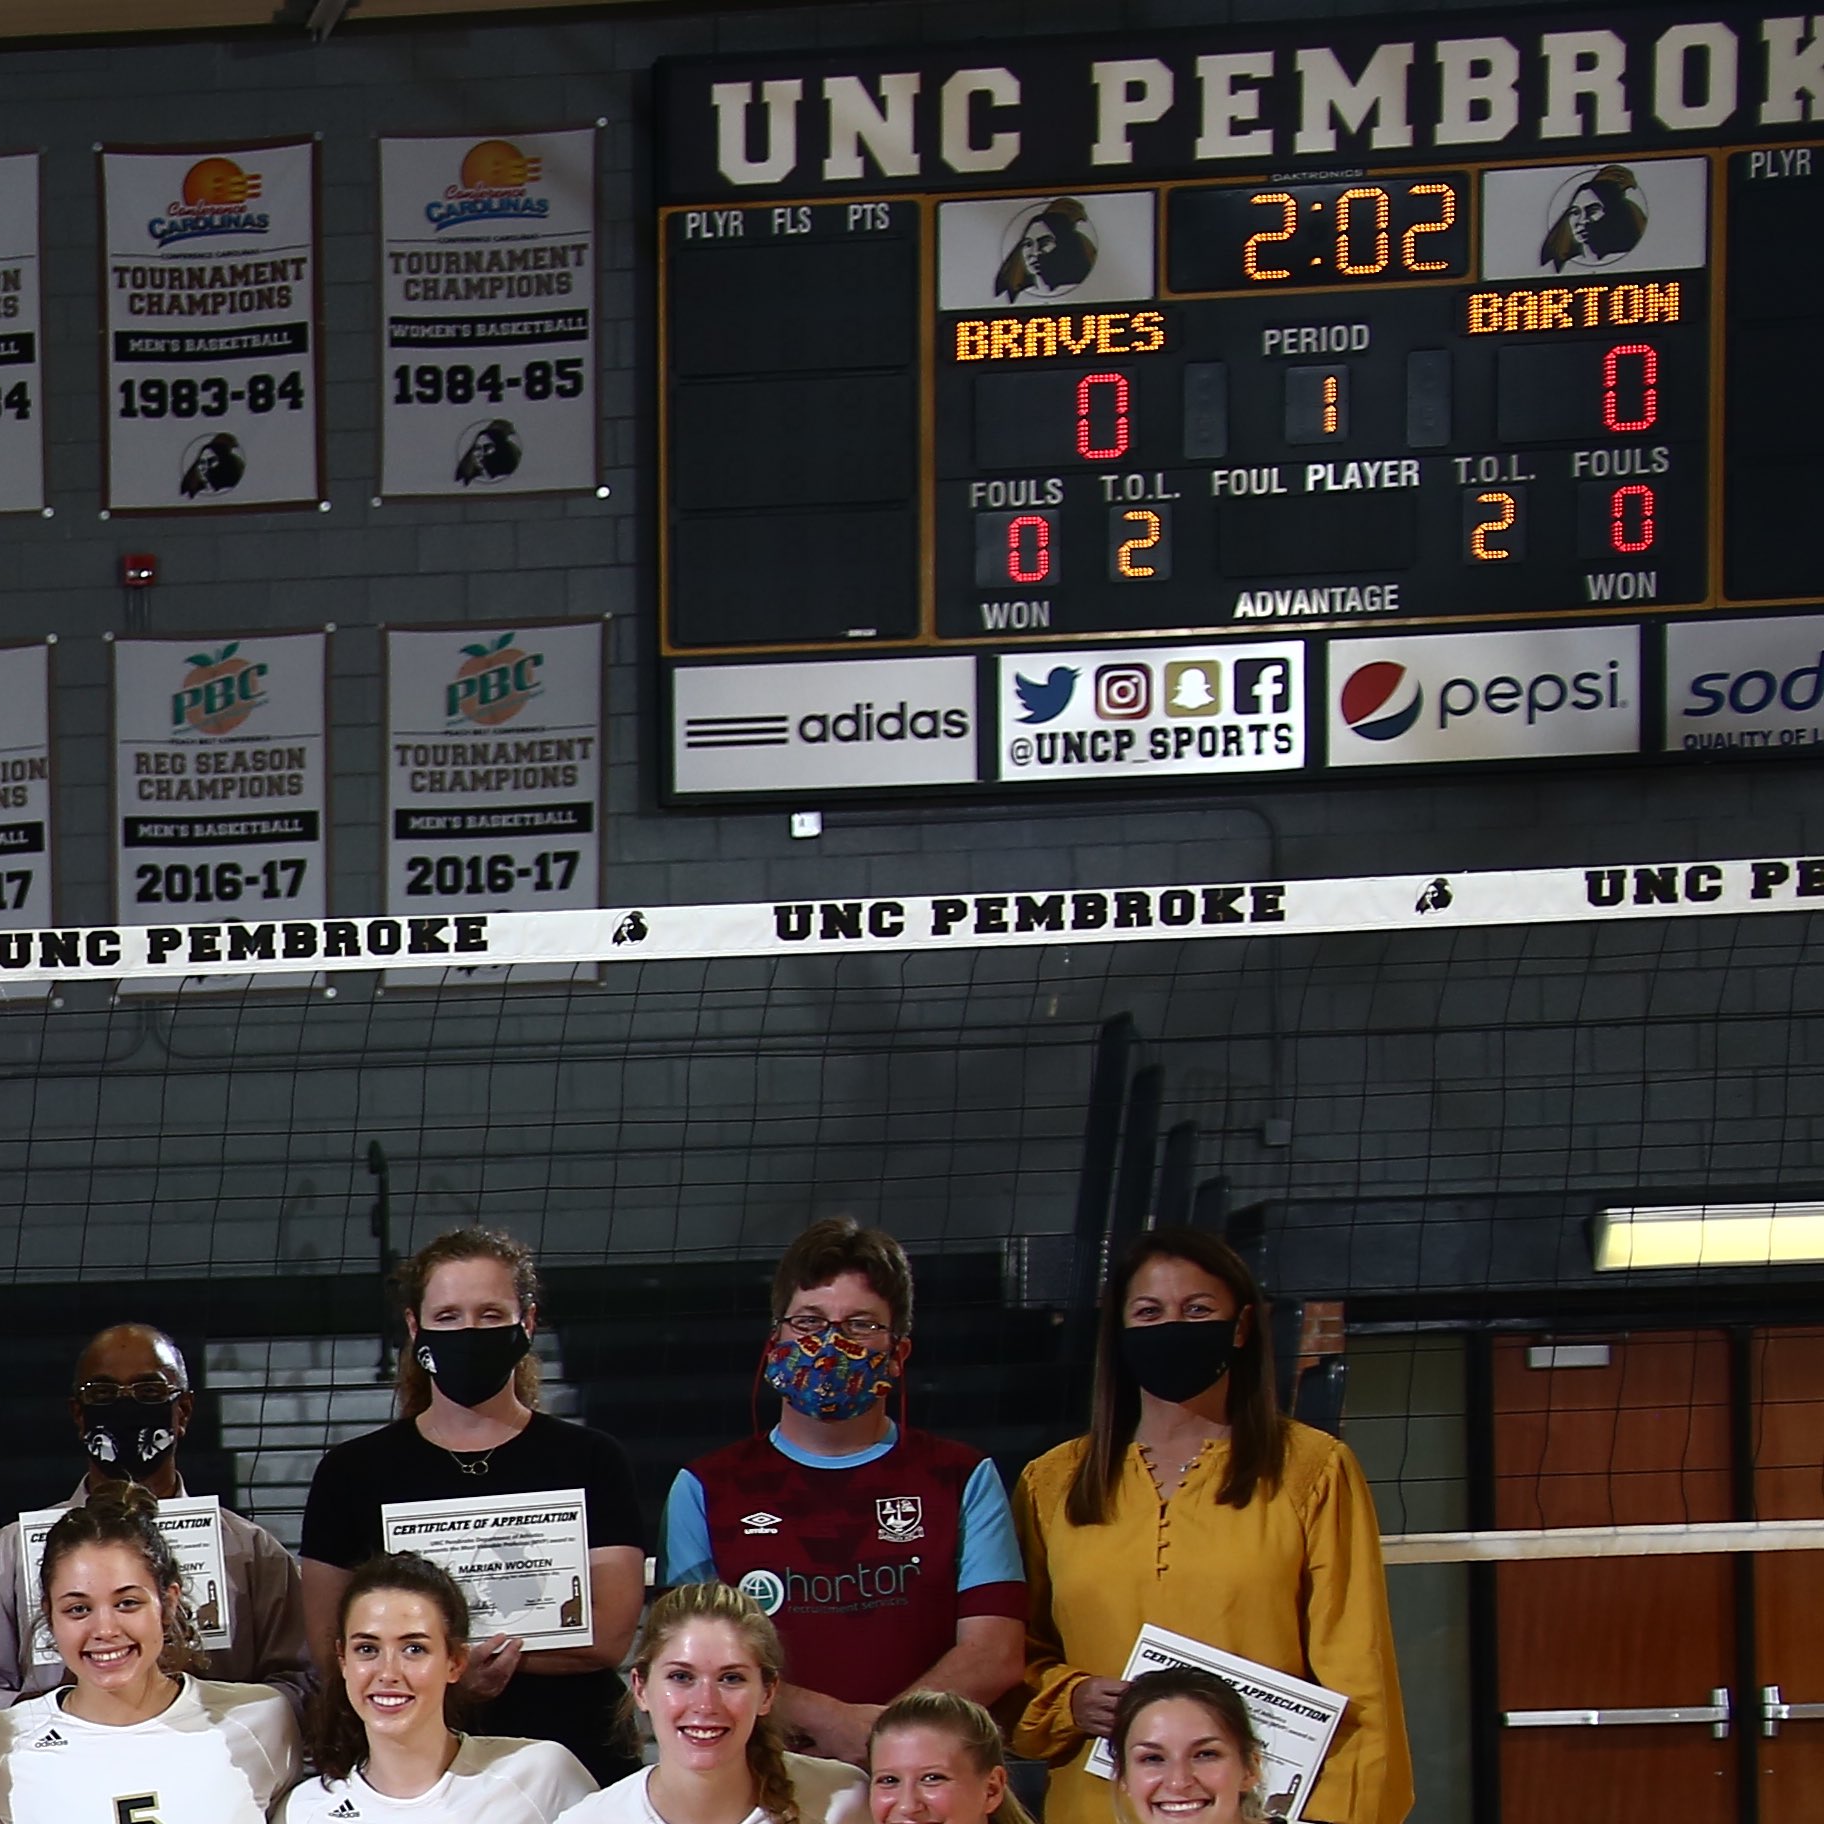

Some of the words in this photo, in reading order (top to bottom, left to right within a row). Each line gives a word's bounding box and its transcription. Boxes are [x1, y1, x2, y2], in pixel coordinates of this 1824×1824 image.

[711, 67, 1021, 187] UNC
[1091, 15, 1824, 167] PEMBROK
[1272, 168, 1364, 182] DAKTRONICS
[1750, 149, 1812, 180] PLYR
[685, 209, 744, 240] PLYR
[772, 207, 812, 236] FLS
[847, 203, 890, 232] PTS
[1242, 182, 1457, 281] 2:02
[1466, 281, 1681, 335] BARTON
[955, 310, 1166, 362] BRAVES
[1262, 323, 1371, 356] PERIOD
[119, 371, 304, 418] 1983-84
[393, 358, 584, 405] 1984-85
[1601, 342, 1658, 433] 0
[1075, 371, 1130, 460] 0
[1322, 374, 1339, 434] 1
[1211, 466, 1288, 497] FOUL
[1305, 459, 1422, 493] PLAYER
[1454, 456, 1536, 485] T.O.L.
[1571, 446, 1670, 478] FOULS
[969, 478, 1065, 509] FOULS
[1098, 473, 1181, 502] T.O.L.
[1471, 490, 1516, 561] 2
[1609, 483, 1655, 553] 0
[1007, 515, 1050, 583] 0
[1117, 509, 1162, 578] 2
[1233, 585, 1400, 619] ADVANTAGE
[1586, 571, 1657, 602] WON
[980, 601, 1050, 630] WON
[446, 654, 544, 718] PBC
[1440, 660, 1620, 729] pepsi
[799, 701, 969, 744] adidas
[1684, 729, 1773, 751] QUALITY
[1780, 728, 1807, 746] OF
[395, 738, 594, 767] TOURNAMENT
[1011, 723, 1293, 767] @UNCP_SPORTS
[410, 765, 578, 794] CHAMPIONS
[408, 813, 463, 831] MEN'S
[464, 809, 578, 831] BASKETBALL
[136, 858, 307, 903] 2016-17
[407, 850, 580, 896] 2016-17
[1585, 864, 1723, 910] UNC
[774, 899, 905, 943] UNC
[931, 886, 1286, 936] PEMBROKE
[148, 916, 489, 962] PEMBROKE
[393, 1520, 471, 1536] CERTIFICATE
[474, 1518, 489, 1529] OF
[491, 1511, 578, 1527] APPRECIATION
[744, 1527, 778, 1535] umbro
[458, 1562, 502, 1574] MARIAN
[505, 1558, 553, 1571] WOOTEN
[1238, 1683, 1331, 1724] APPRECIATION
